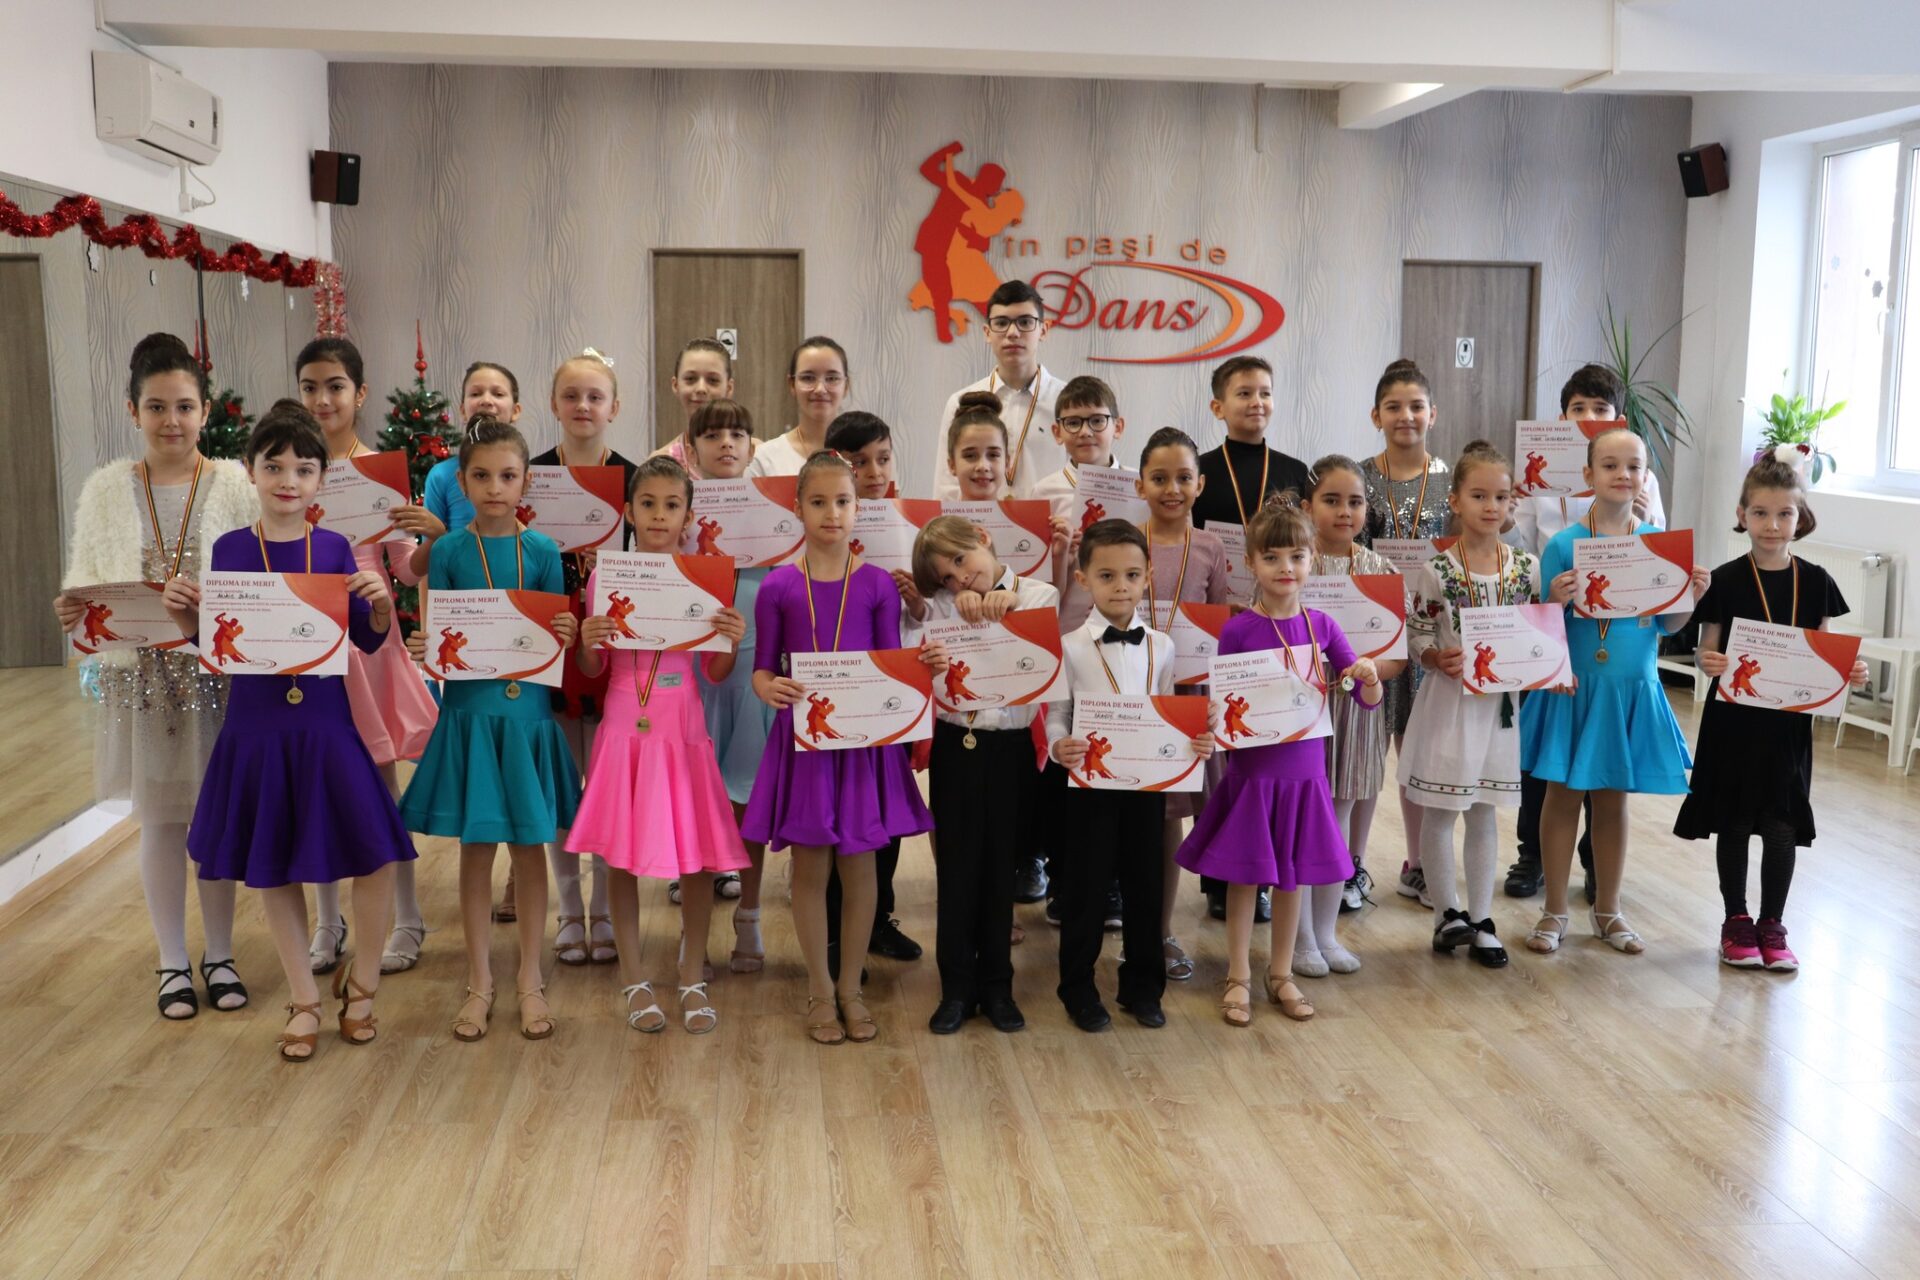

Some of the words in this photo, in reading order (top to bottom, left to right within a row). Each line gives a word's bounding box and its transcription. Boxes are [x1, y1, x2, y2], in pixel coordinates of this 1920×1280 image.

[1179, 238, 1227, 265] de
[1030, 262, 1210, 331] Dans
[326, 465, 345, 473] MERIT
[602, 558, 632, 566] DIPLOMA
[930, 625, 960, 635] DIPLOMA
[971, 622, 991, 630] MERIT
[1736, 624, 1766, 635] DIPLOMA
[1776, 631, 1796, 640] MERIT
[1214, 662, 1242, 670] DIPLOMA
[1252, 657, 1269, 665] MERIT
[1080, 700, 1112, 708] DIPLOMA
